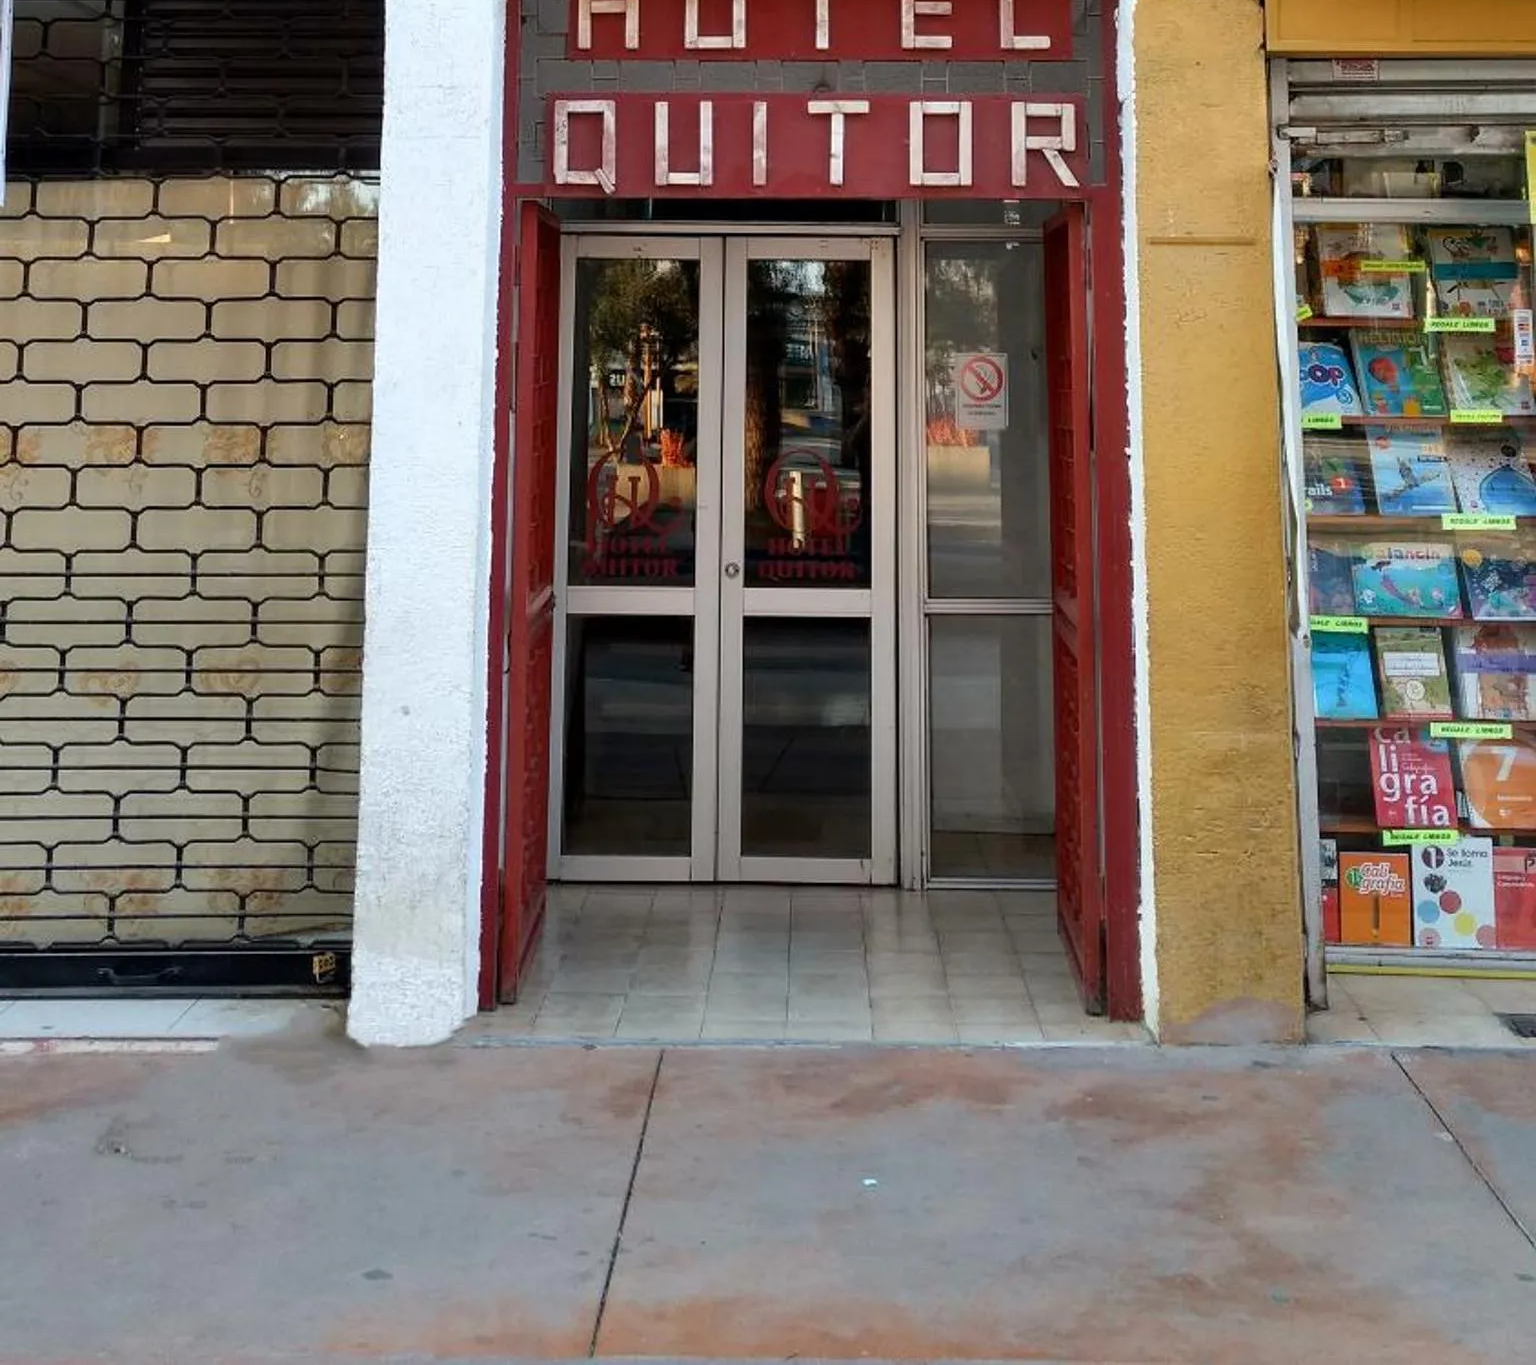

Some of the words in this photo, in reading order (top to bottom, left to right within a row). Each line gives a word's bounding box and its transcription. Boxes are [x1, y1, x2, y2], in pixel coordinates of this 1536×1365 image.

[553, 99, 1080, 195] QUITOR
[1379, 744, 1399, 772] li
[1491, 746, 1517, 781] 7
[1380, 772, 1438, 802] gra
[1404, 795, 1451, 826] fía
